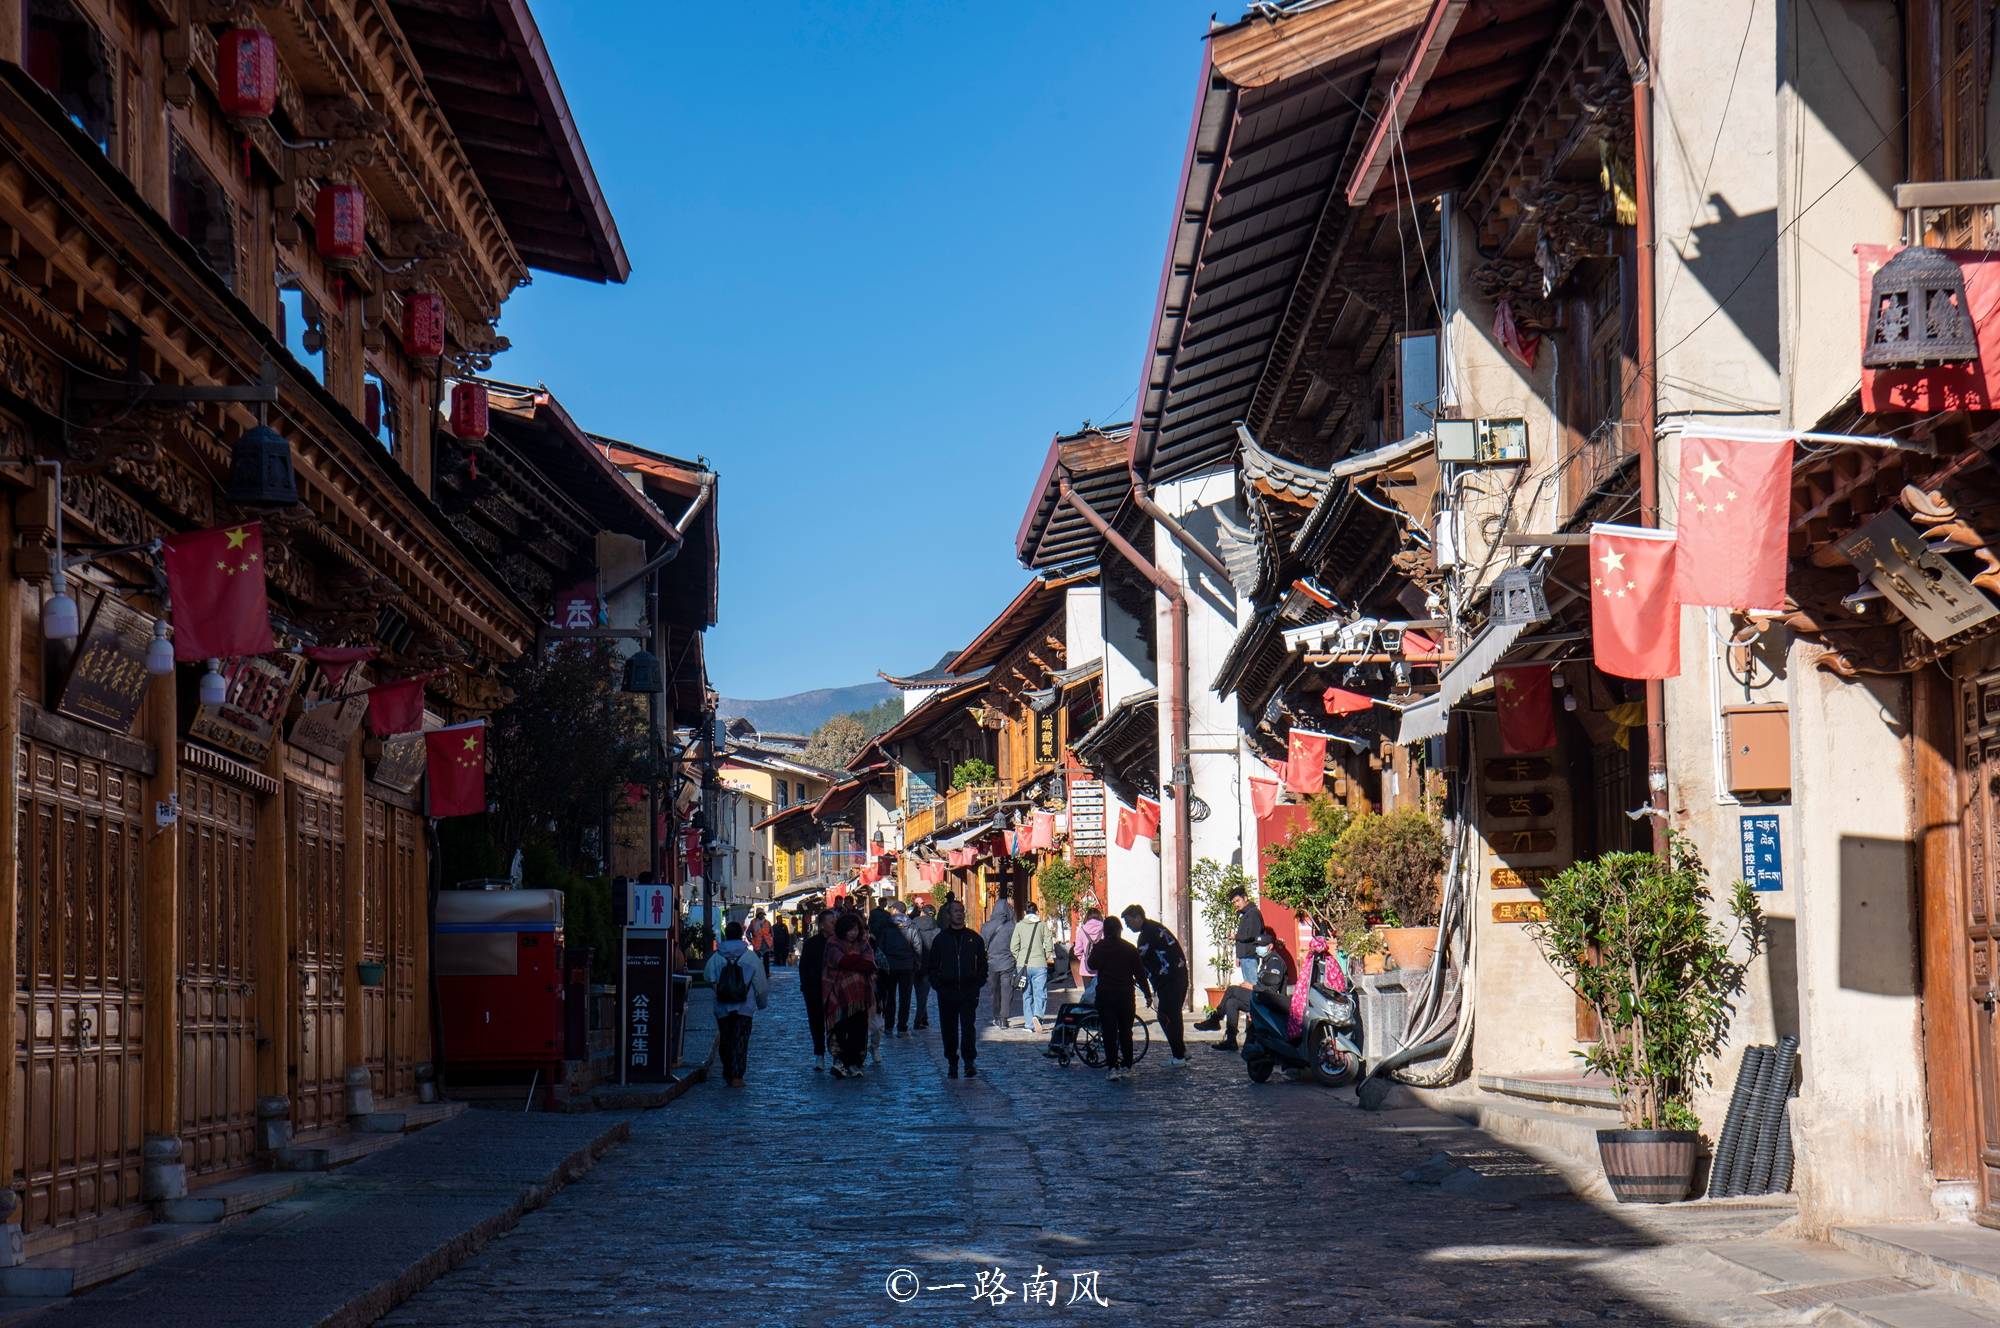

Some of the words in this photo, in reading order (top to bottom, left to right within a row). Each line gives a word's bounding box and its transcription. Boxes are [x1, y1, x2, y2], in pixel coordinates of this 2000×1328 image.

[1508, 760, 1530, 781] 卡
[631, 993, 650, 1067] 公共卫生间
